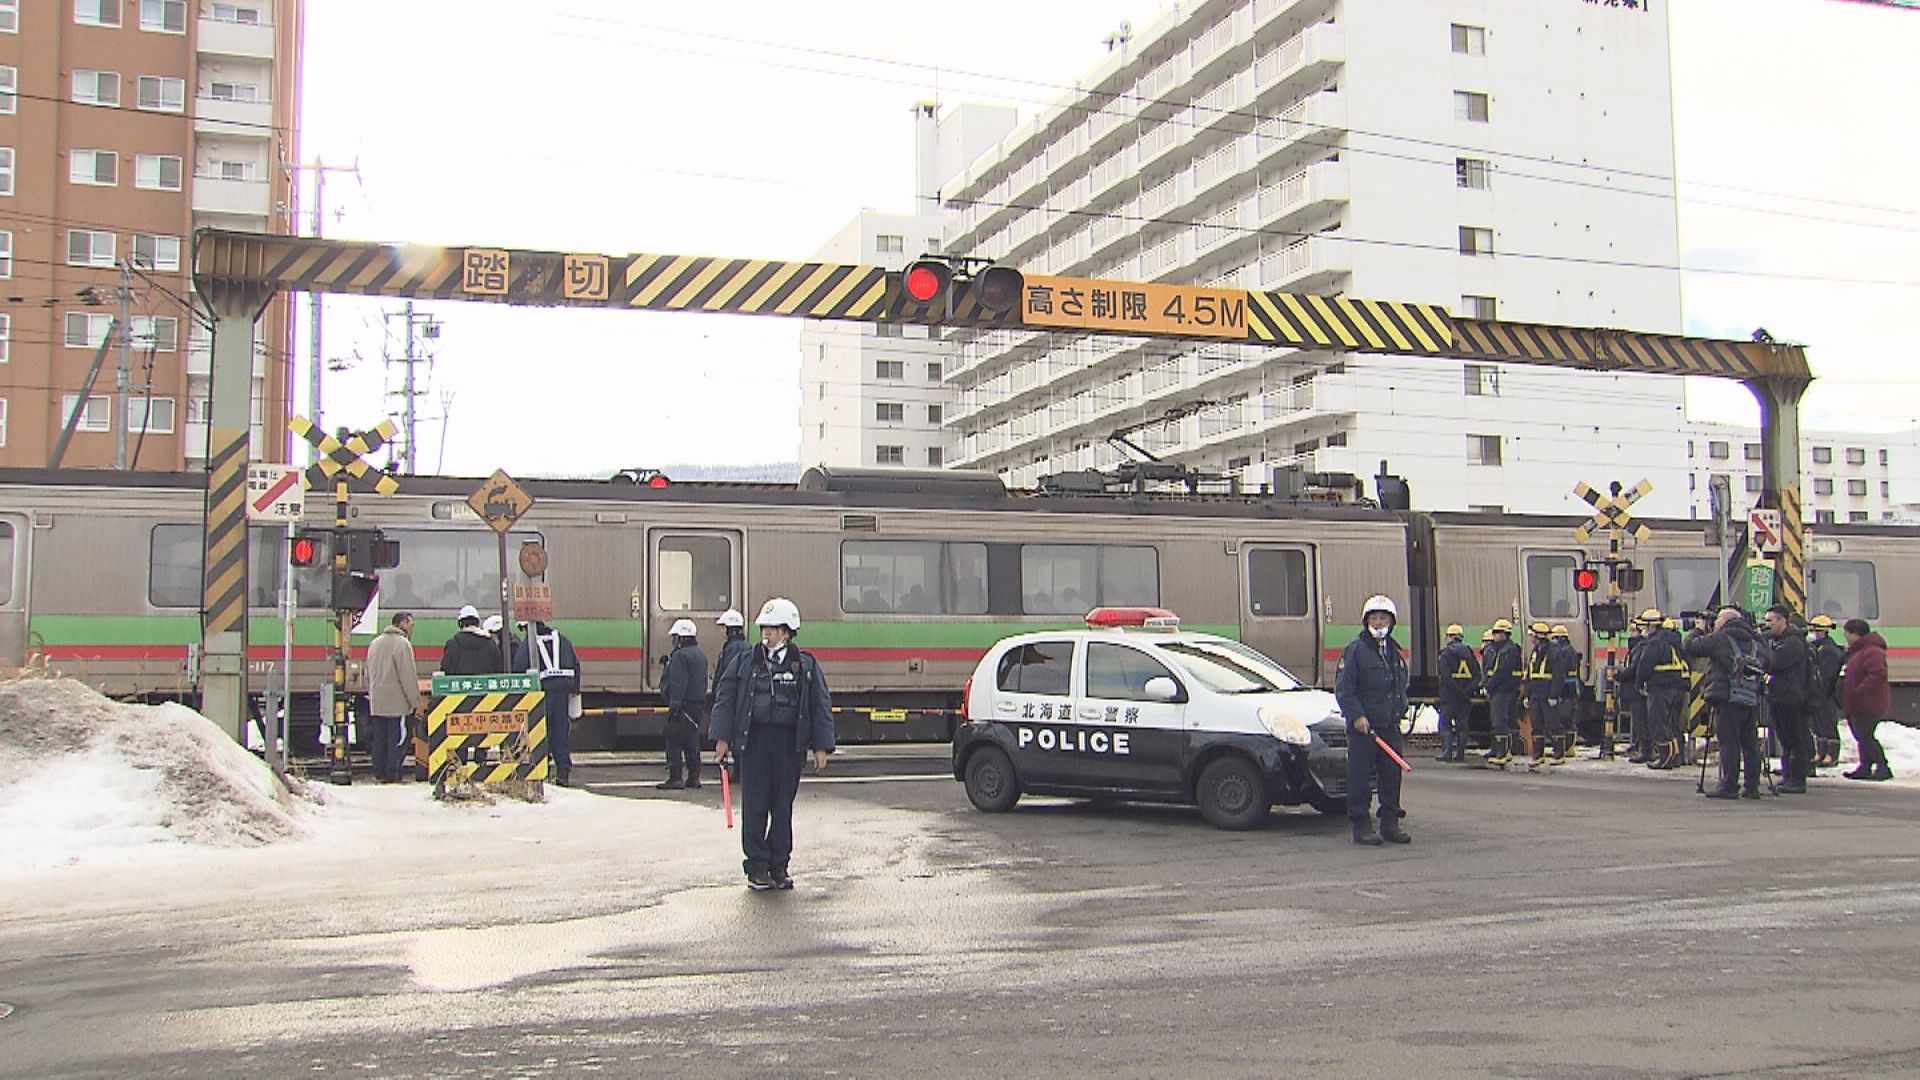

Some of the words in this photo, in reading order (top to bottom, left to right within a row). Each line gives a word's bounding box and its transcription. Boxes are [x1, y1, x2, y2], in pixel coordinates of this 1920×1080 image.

[467, 253, 604, 295] 踏切
[1027, 285, 1147, 321] 高さ制限
[1163, 295, 1243, 328] 4.5M
[274, 502, 301, 516] 注意
[1751, 567, 1769, 608] 踏切
[1022, 702, 1140, 724] 北海道警察
[1018, 727, 1130, 754] POLICE
